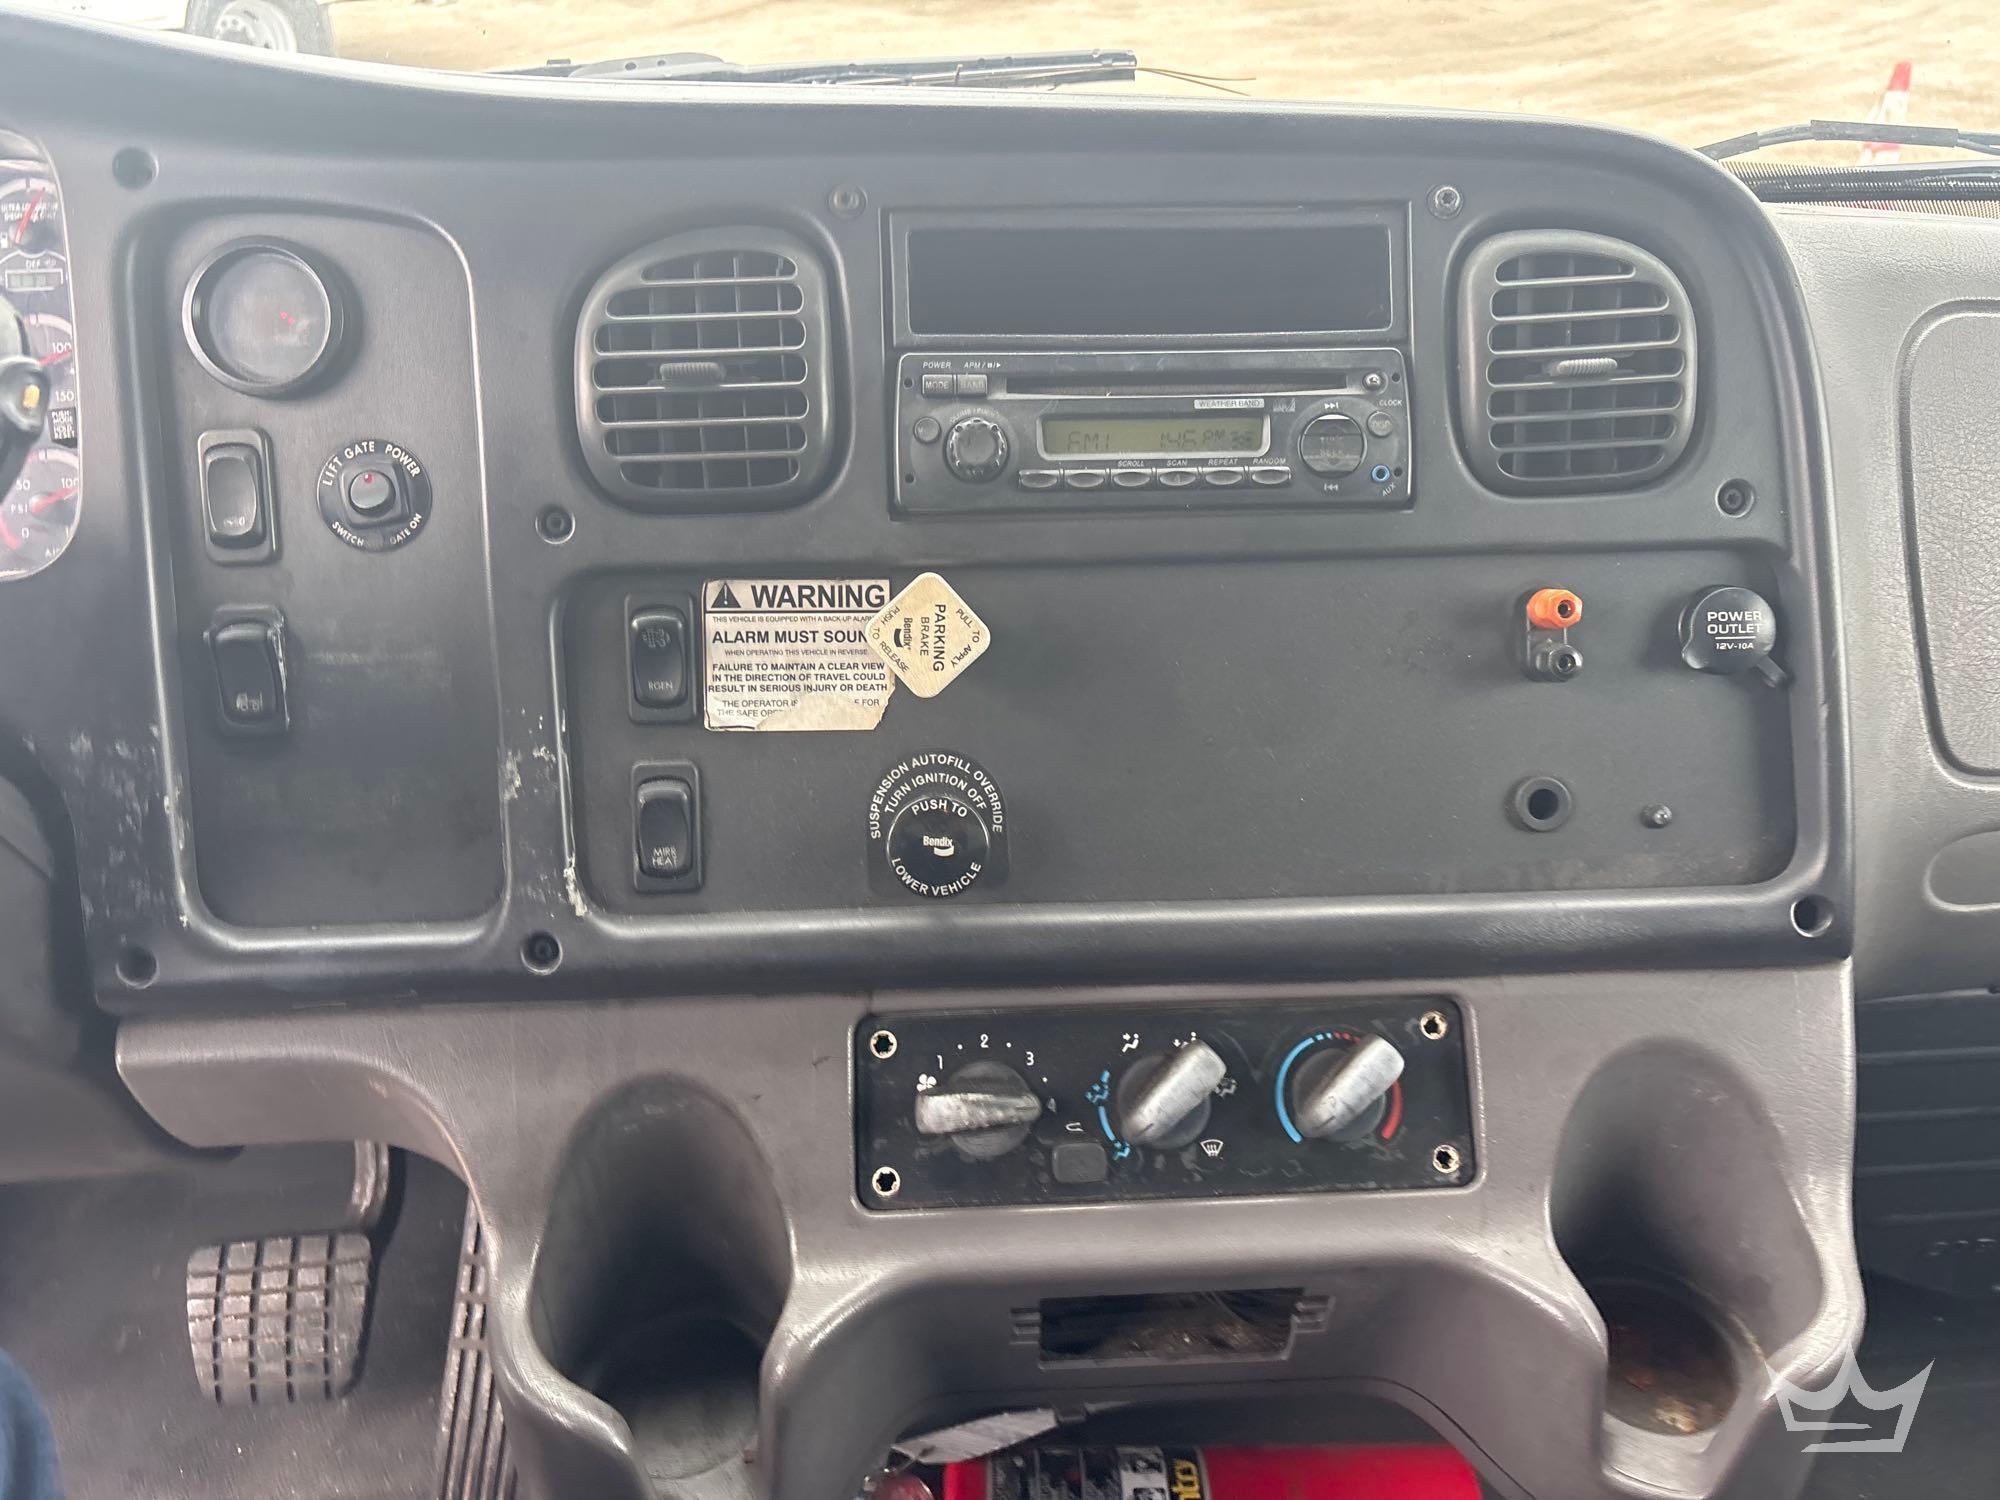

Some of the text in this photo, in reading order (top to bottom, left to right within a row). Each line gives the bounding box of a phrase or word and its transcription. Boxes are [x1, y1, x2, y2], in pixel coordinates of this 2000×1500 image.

[922, 361, 951, 369] POWER
[925, 381, 950, 391] MODE
[55, 391, 75, 402] 150
[1200, 399, 1261, 408] WEATHER BAND
[322, 441, 421, 486] LIFT GATE POWER
[1166, 459, 1188, 467] SCAN
[1208, 458, 1238, 466] REPEAT
[1252, 457, 1286, 465] RANDOM
[1382, 482, 1397, 497] AUX
[332, 512, 423, 547] SWITCH GATE ON
[751, 584, 885, 609] WARNING
[1707, 611, 1762, 622] POWER
[903, 617, 913, 648] Bendix
[1707, 623, 1762, 634] OUTLET
[712, 630, 867, 643] ALARM MUST SOUN
[872, 606, 909, 673] PUSH TO RELEASE
[920, 616, 930, 656] BRAKE
[933, 604, 947, 672] PARKING
[951, 608, 980, 668] PULL TO APPLY
[1716, 642, 1753, 650] 12V-10A
[712, 663, 752, 671] FAILURE
[755, 663, 768, 671] TO
[770, 663, 816, 671] MAINTAIN
[861, 662, 885, 670] VIEW
[712, 673, 886, 682] IN THE DIRECTION OF TRAVEL COULD
[708, 683, 888, 692] RESULT IN SERIOUS INJURY OR DEATH
[722, 700, 739, 708] THE
[741, 699, 789, 707] OPERATOR
[862, 698, 880, 706] FOR
[736, 709, 758, 717] SAFE
[869, 753, 1003, 839] SUSPENSION AUTOFILL OVERRIDE
[884, 772, 987, 814] TURN IGNITION OFF
[911, 799, 968, 818] PUSH TO
[923, 835, 953, 847] Bendix
[652, 857, 677, 867] HEAT
[891, 857, 982, 896] LOWER VEHICLE
[980, 1034, 989, 1049] 2
[936, 1054, 943, 1070] 1
[1026, 1052, 1035, 1066] 3
